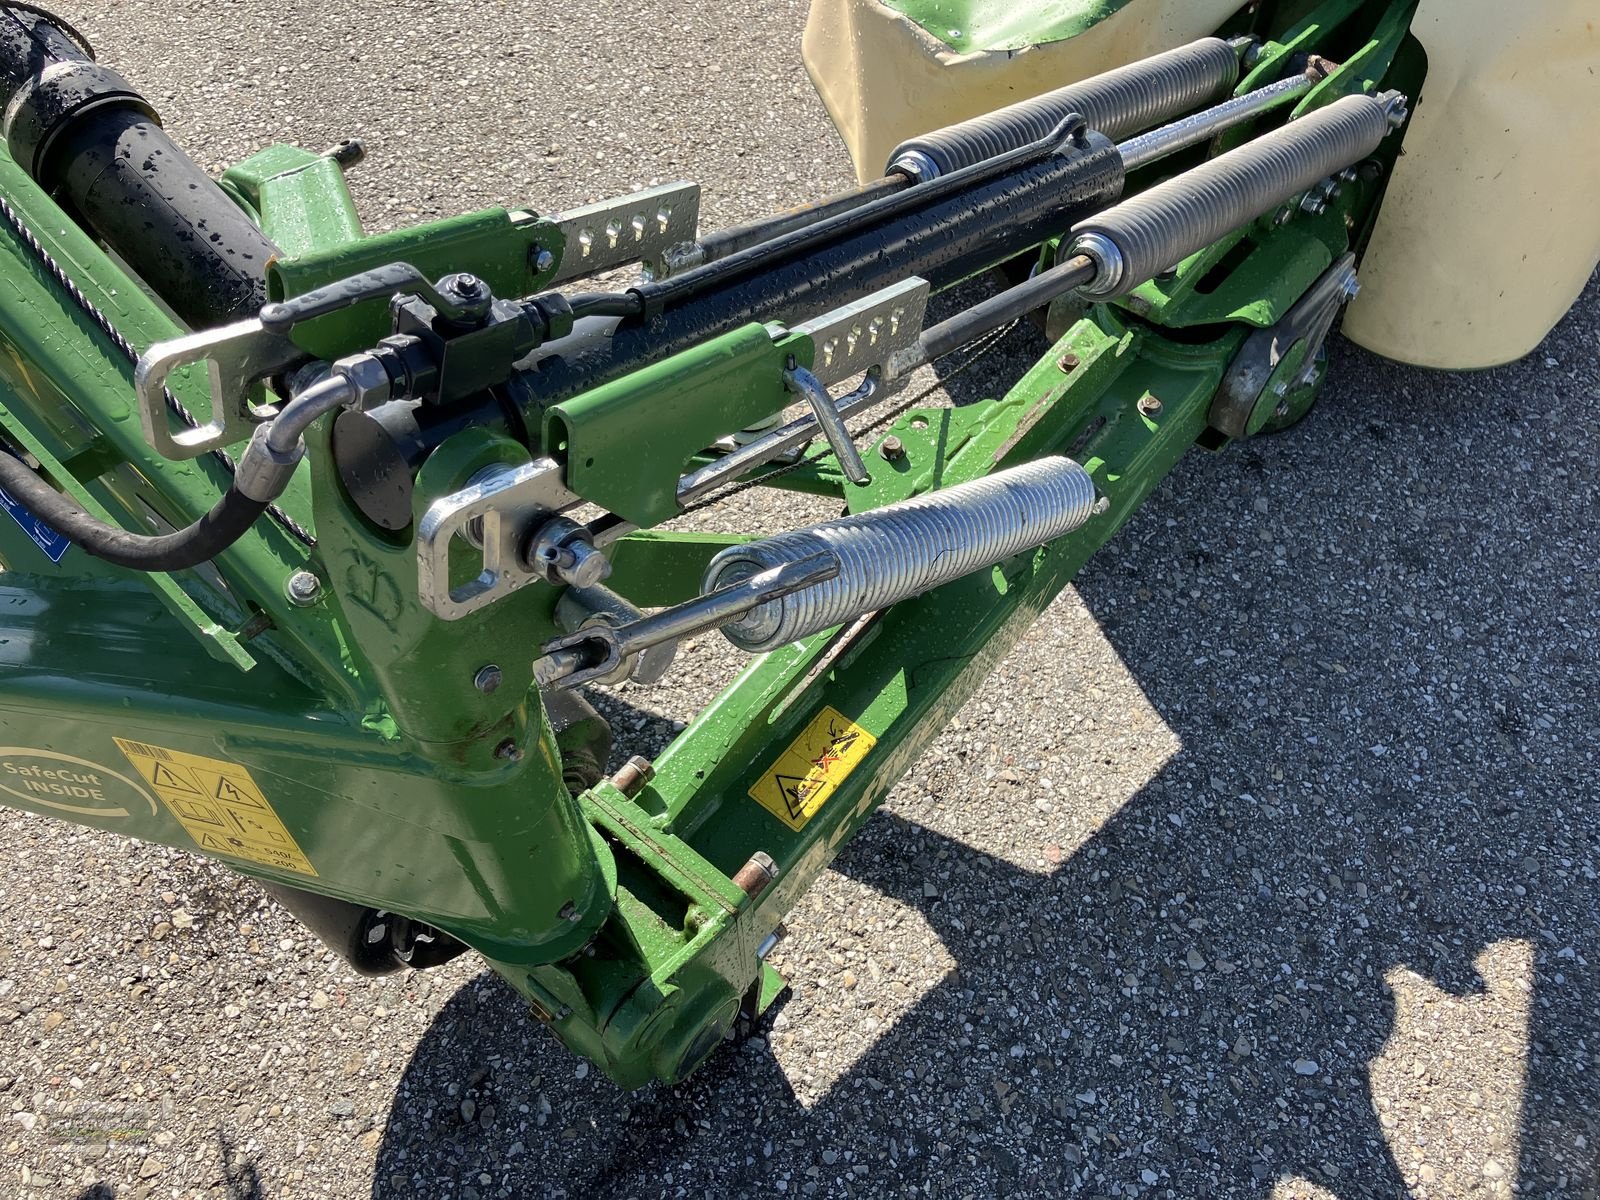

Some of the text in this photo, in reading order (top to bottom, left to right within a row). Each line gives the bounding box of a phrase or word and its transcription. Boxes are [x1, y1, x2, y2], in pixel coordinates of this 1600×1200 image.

[2, 762, 102, 786] SafeCut
[22, 779, 106, 801] INSIDE
[273, 858, 297, 869] 200
